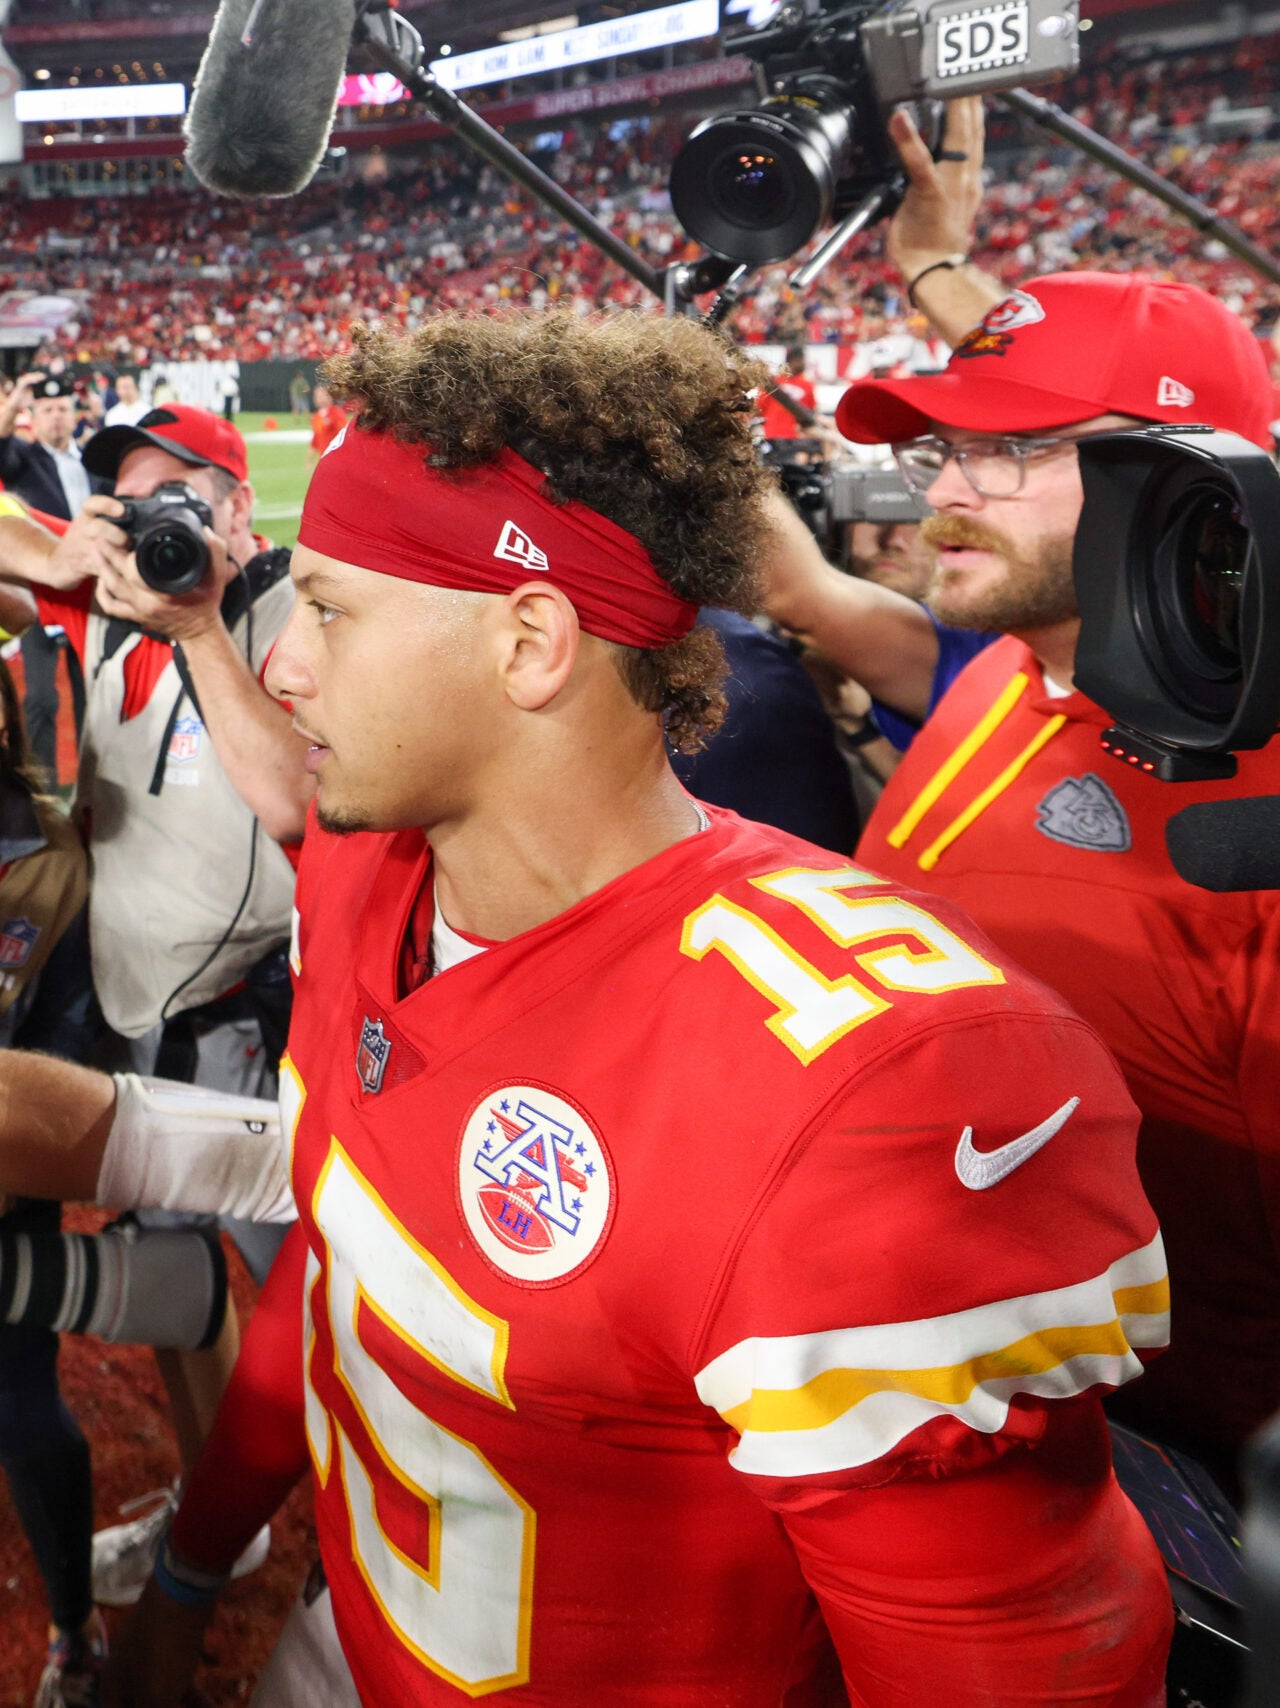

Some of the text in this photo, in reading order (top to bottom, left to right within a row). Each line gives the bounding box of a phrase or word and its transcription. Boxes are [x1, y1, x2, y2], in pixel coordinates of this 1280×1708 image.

[943, 14, 1021, 63] SDS
[678, 863, 1007, 1068] 15
[496, 1200, 533, 1240] LH
